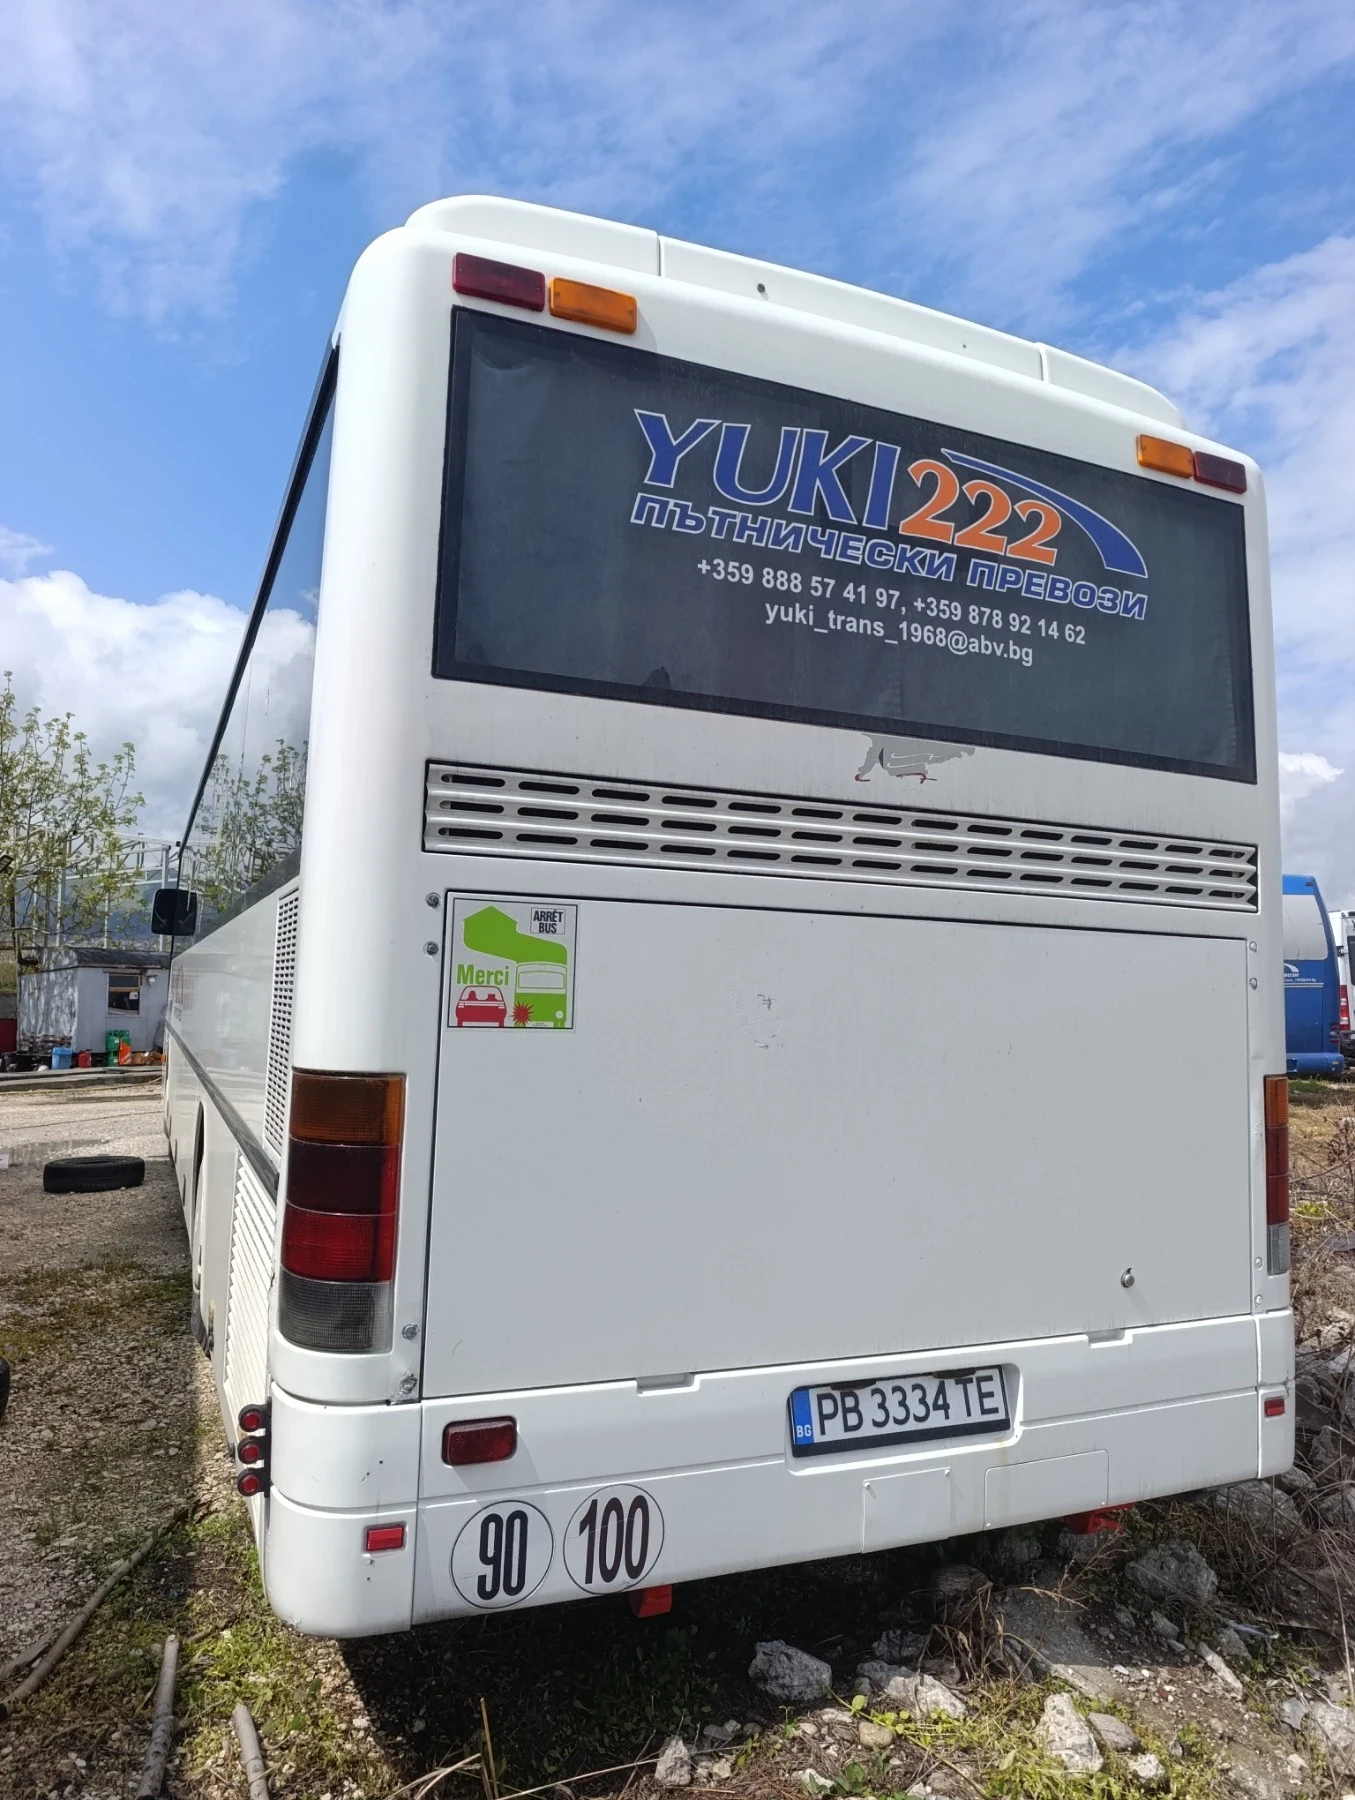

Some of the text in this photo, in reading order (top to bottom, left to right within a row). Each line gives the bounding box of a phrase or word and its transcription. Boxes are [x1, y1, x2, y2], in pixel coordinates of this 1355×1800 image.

[634, 408, 1063, 567] YUKI 222
[630, 493, 1149, 620] ПЪТНИЧЕСКИ ПРЕВОЗИ
[697, 558, 1086, 645] +359 888 57 41 97, +359 878 92 14 62
[765, 603, 1033, 667] yuki_trans_1968@abv.bg
[533, 909, 564, 923] ARRÊT
[538, 922, 557, 934] BUS
[456, 964, 510, 985] Merci
[797, 1425, 812, 1438] BG
[816, 1375, 999, 1436] PB 3334 TE
[477, 1510, 528, 1600] 90
[579, 1495, 650, 1585] 100
